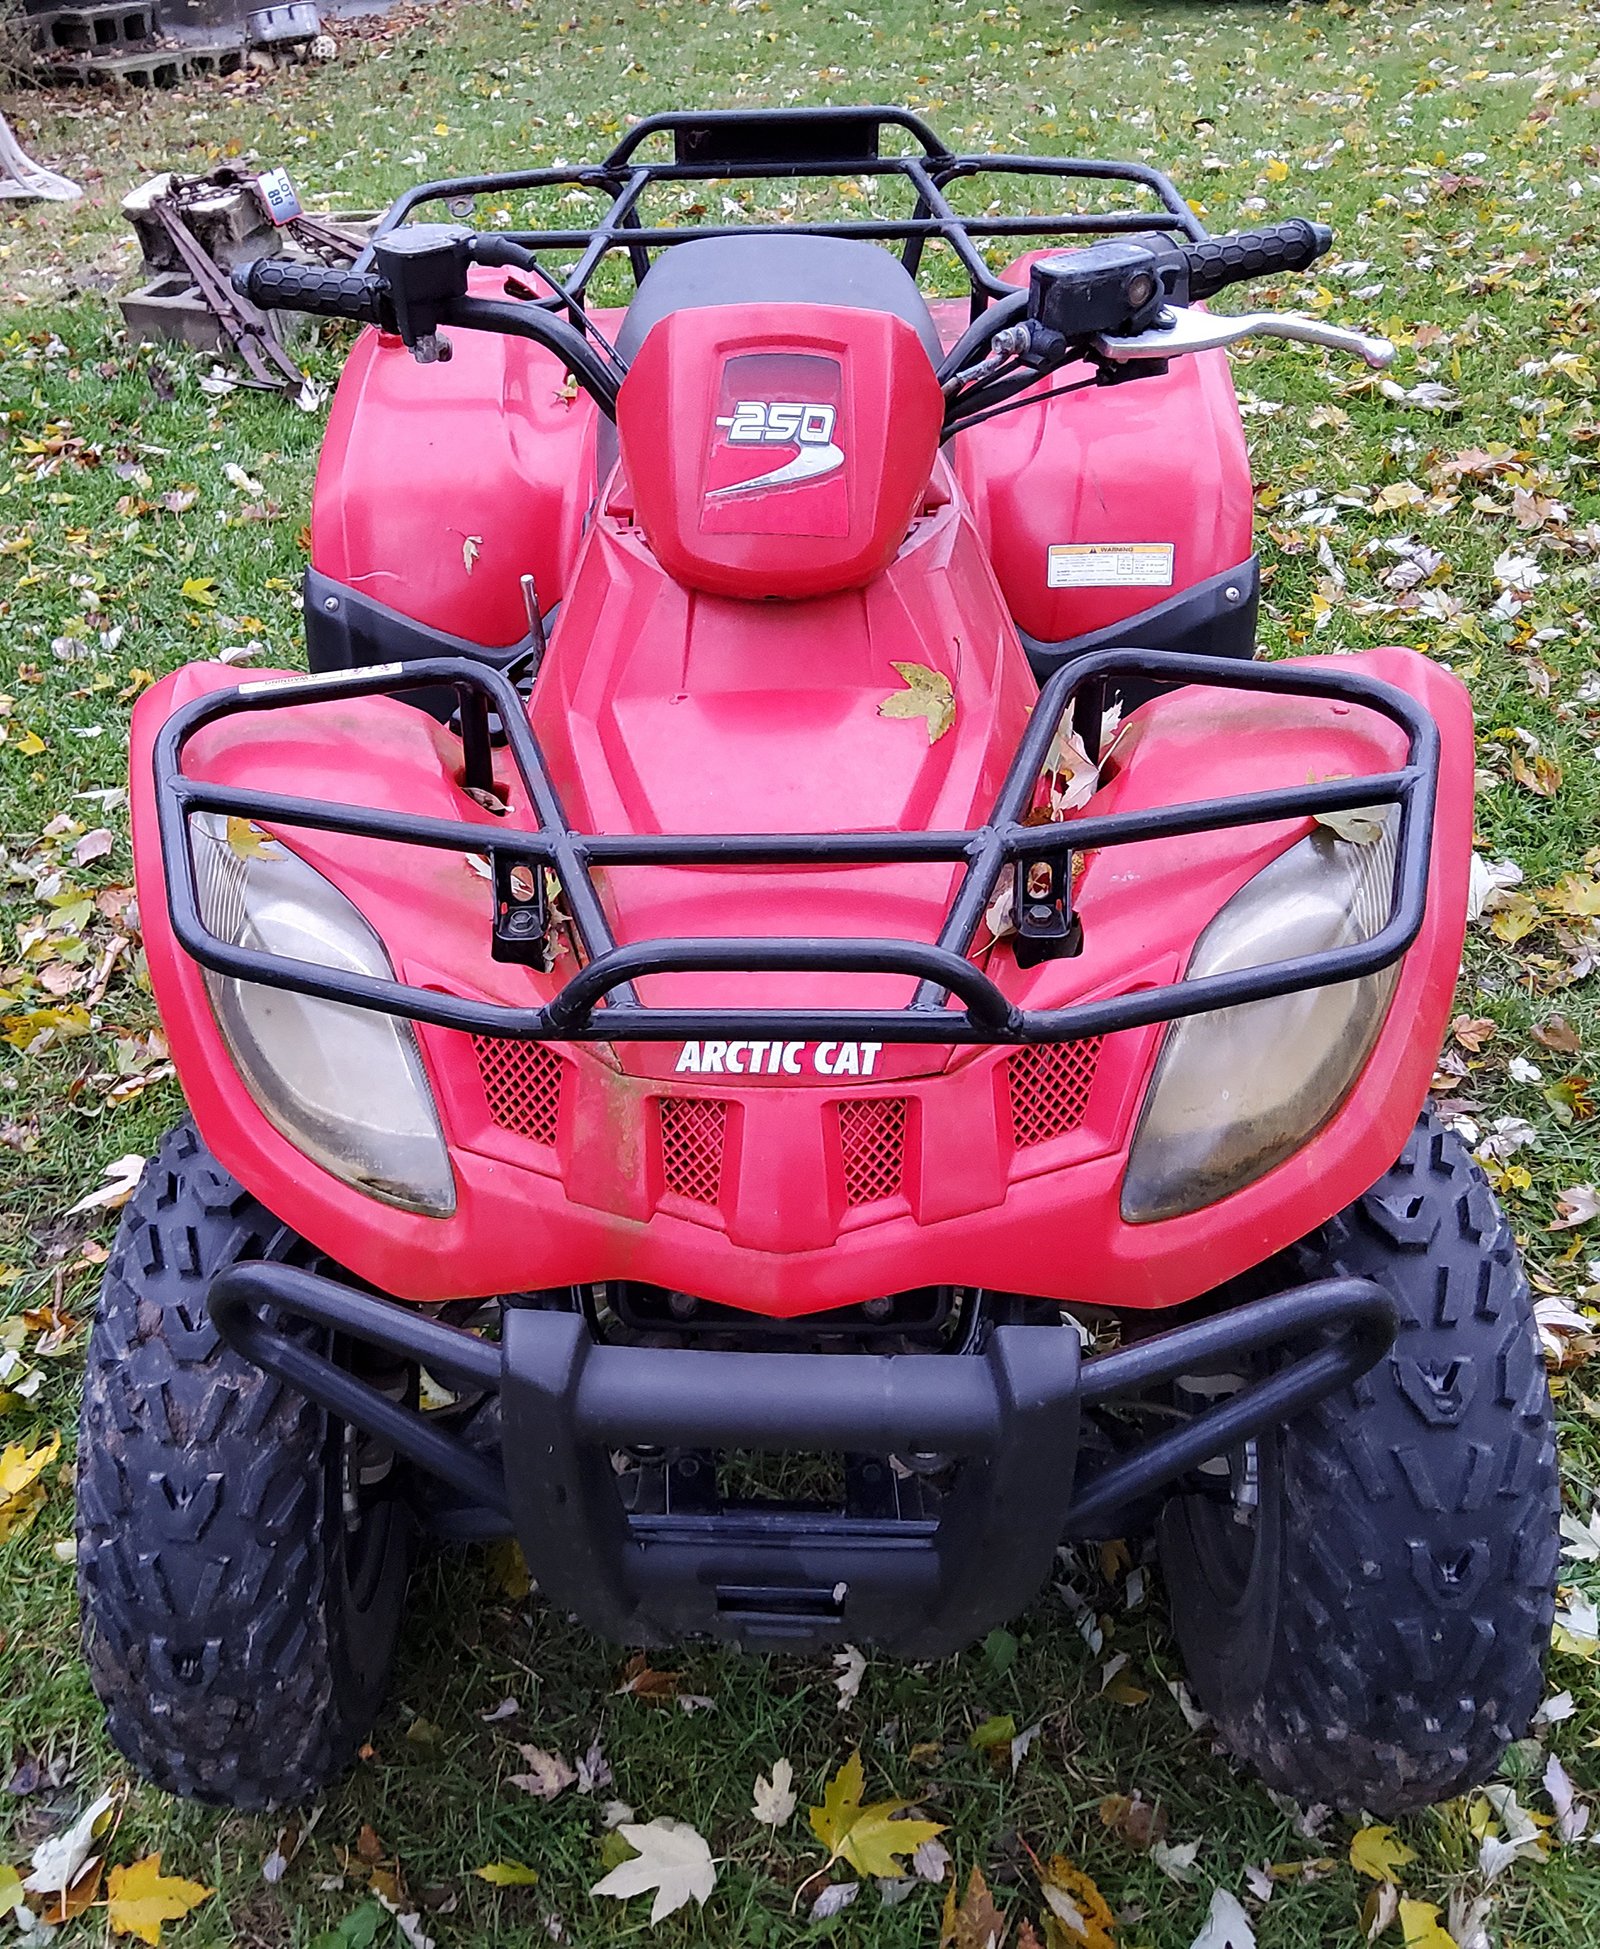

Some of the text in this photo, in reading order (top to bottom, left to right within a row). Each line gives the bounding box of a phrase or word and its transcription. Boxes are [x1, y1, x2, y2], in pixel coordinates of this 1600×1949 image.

[267, 188, 284, 207] 89
[277, 176, 294, 198] LOT
[727, 400, 837, 445] 250
[674, 1040, 883, 1076] ARCTIC CAT
